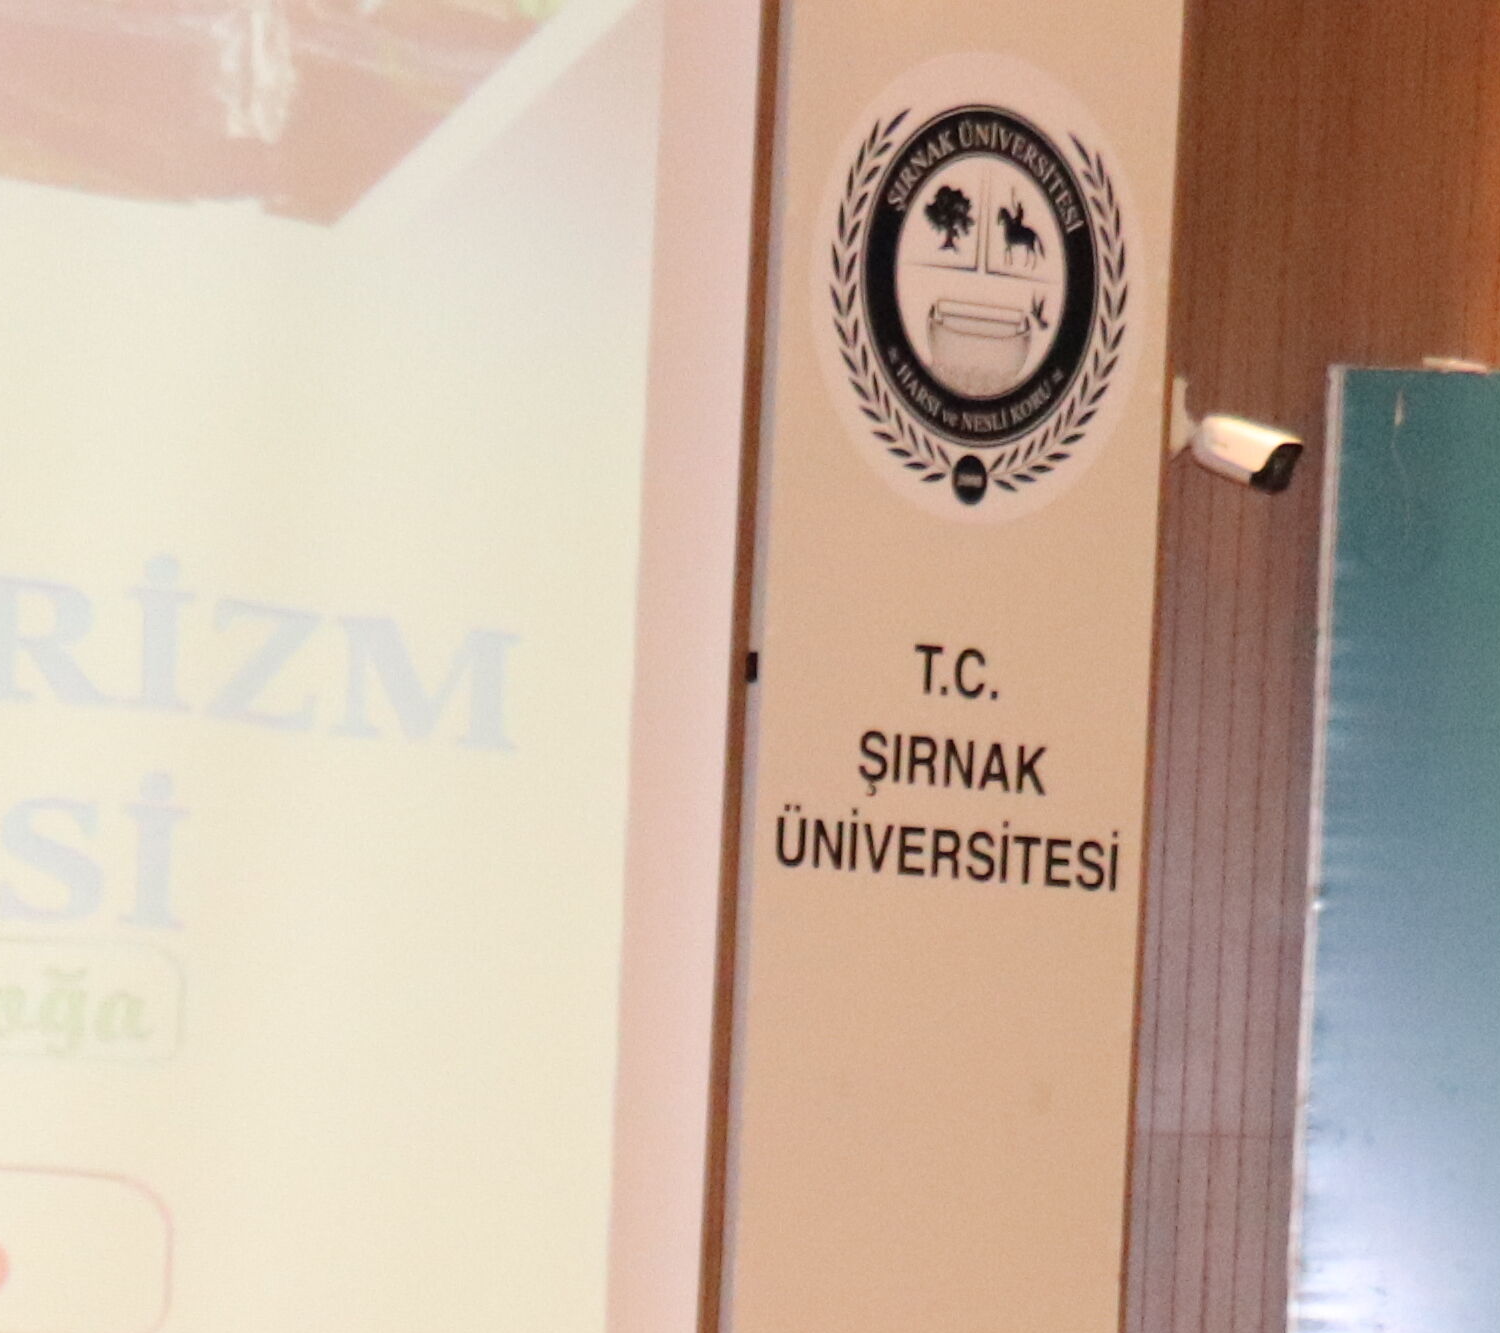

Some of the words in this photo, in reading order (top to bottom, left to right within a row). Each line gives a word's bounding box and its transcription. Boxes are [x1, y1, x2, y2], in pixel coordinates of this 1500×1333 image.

[915, 644, 998, 700] T.C.
[859, 730, 1046, 797] ŞIRNAK
[776, 804, 1120, 891] ÜNİVERSİTESİ
